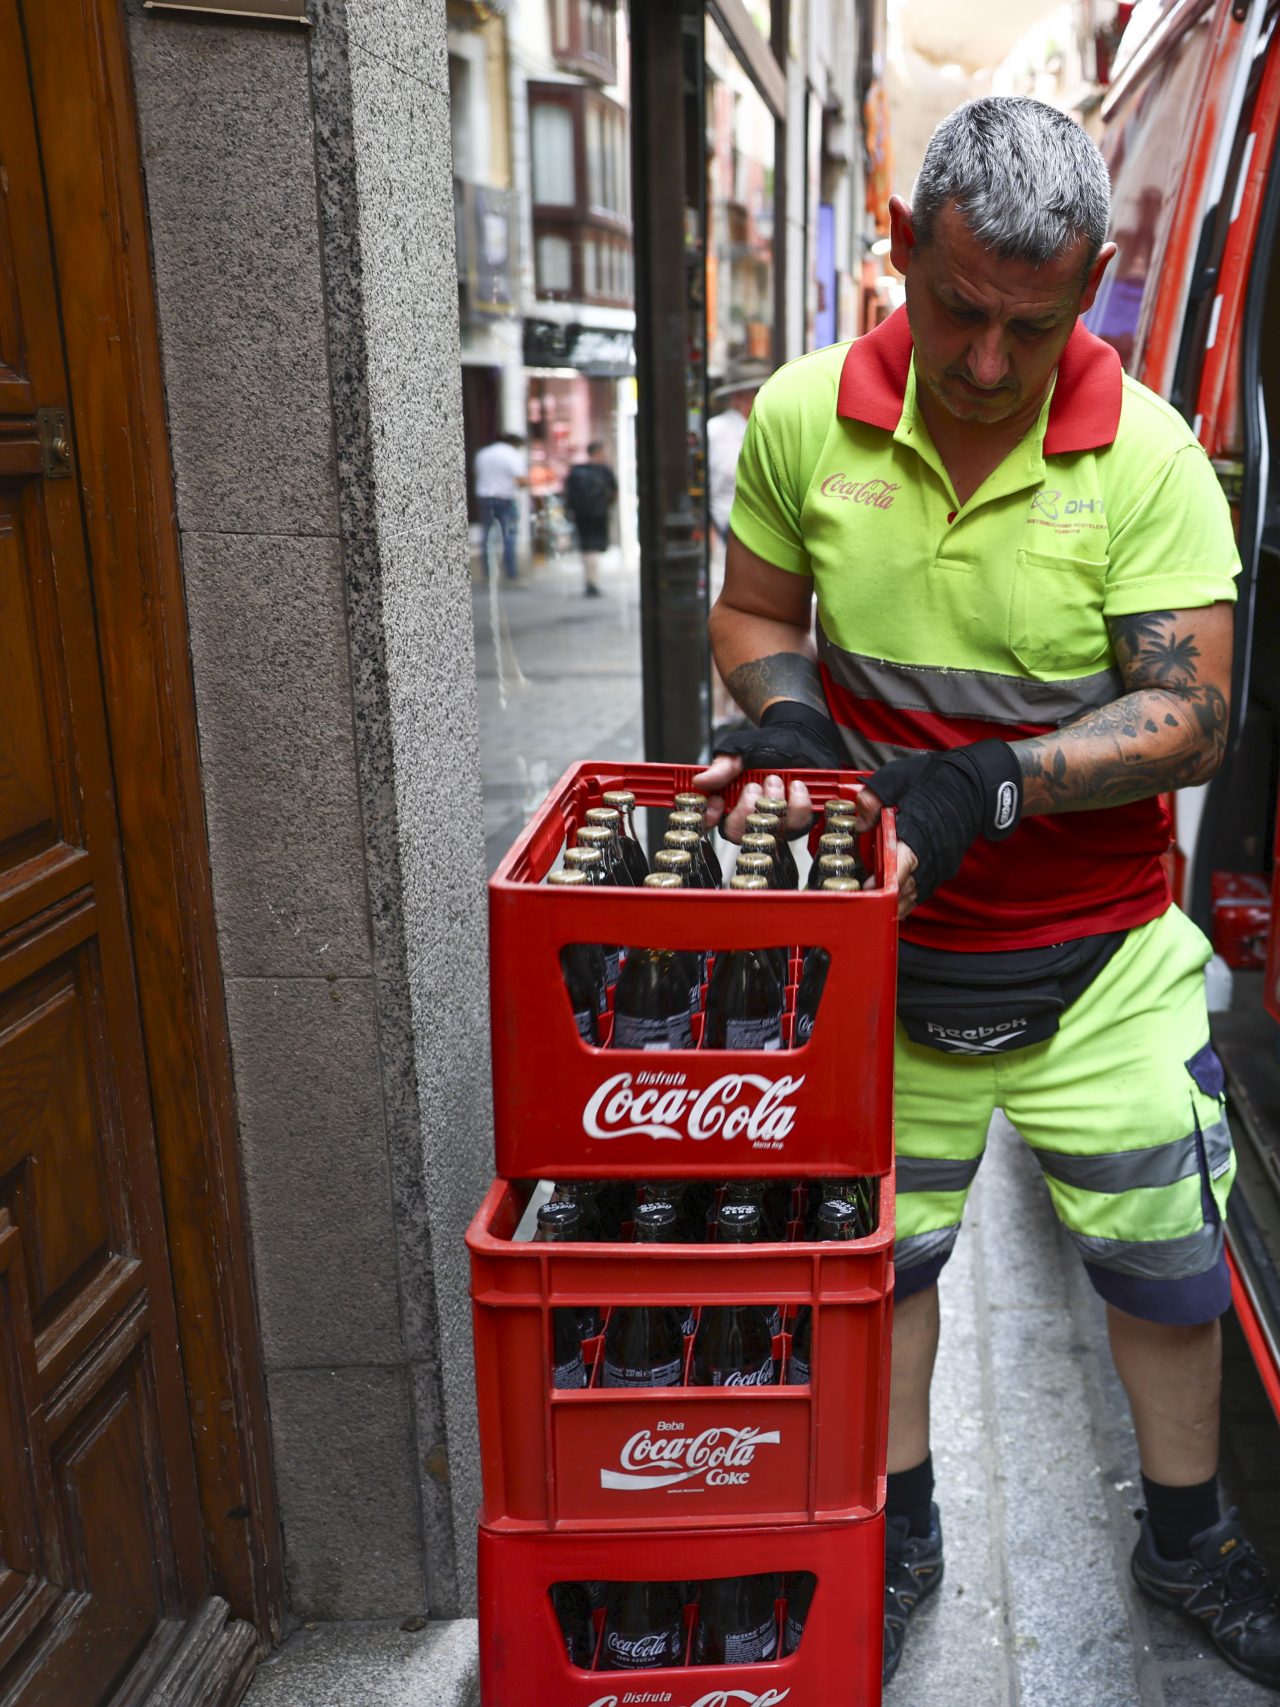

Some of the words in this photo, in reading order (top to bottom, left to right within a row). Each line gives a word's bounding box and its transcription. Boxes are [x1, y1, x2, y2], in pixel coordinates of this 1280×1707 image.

[926, 1017, 1028, 1040] Reebok
[635, 1070, 687, 1086] Disfruta
[582, 1072, 806, 1141] Coca-Cola
[656, 1420, 685, 1432] Beba
[620, 1426, 761, 1470] Coca-Cola
[705, 1469, 750, 1486] Coke
[608, 1630, 669, 1658] Coca-Cola
[622, 1691, 672, 1704] Disfruta
